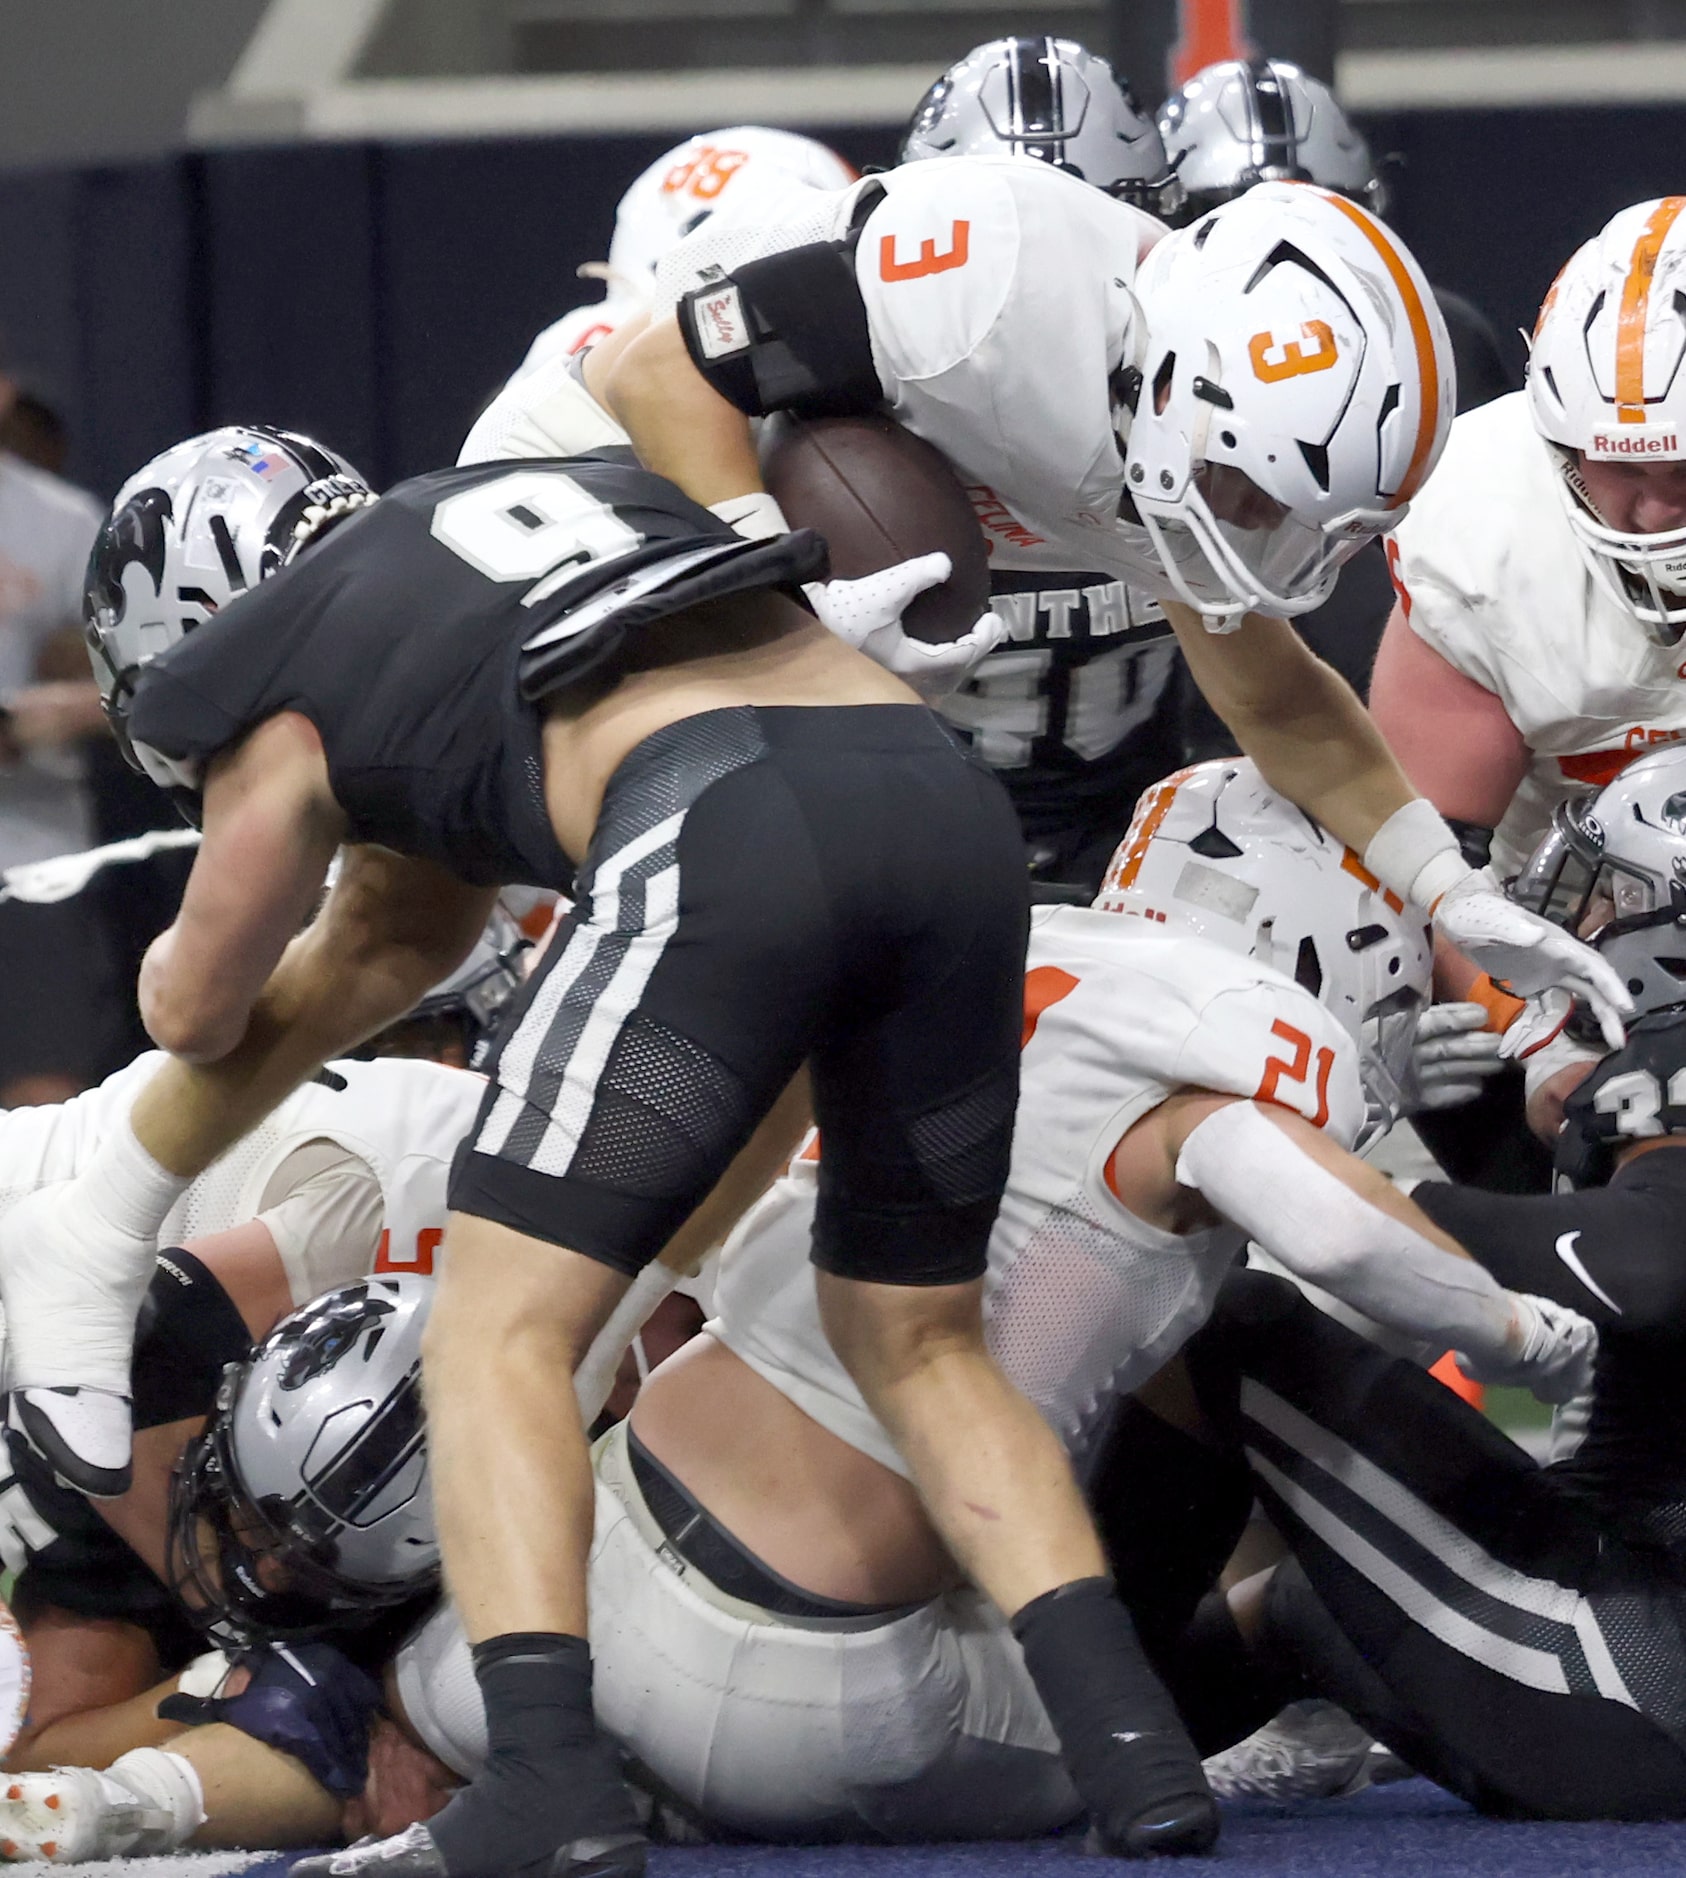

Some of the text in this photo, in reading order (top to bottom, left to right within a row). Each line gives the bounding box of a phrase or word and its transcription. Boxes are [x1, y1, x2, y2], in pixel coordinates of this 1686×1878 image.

[879, 219, 970, 283] 3
[1248, 319, 1339, 384] 3
[1594, 434, 1678, 453] Riddell
[1252, 1017, 1336, 1129] 21
